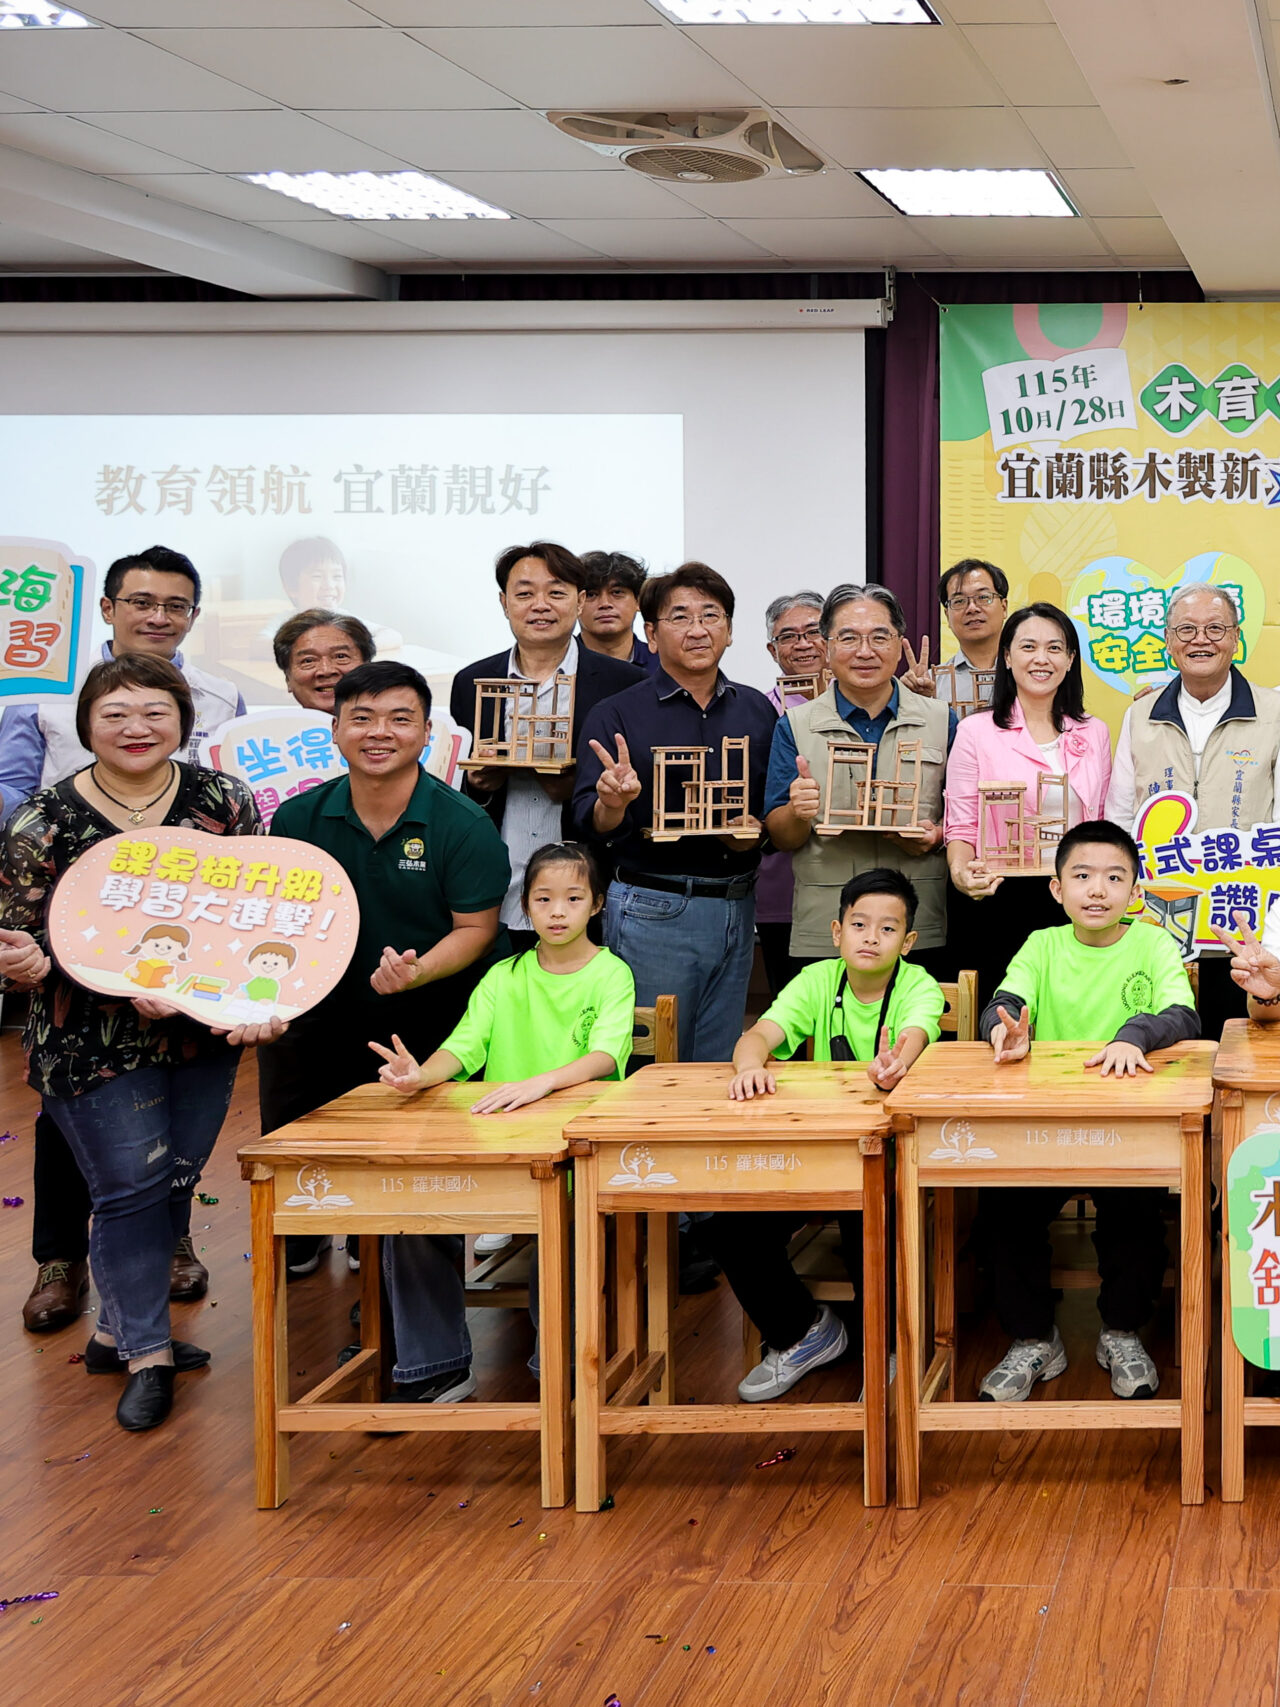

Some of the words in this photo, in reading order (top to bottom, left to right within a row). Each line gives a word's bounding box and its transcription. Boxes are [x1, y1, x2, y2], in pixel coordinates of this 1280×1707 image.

[1015, 363, 1098, 399] 115年
[999, 395, 1126, 437] 10月/28日
[94, 463, 313, 517] 教育領航
[332, 463, 553, 517] 宜蘭靚好
[1001, 452, 1280, 500] 宜蘭縣木製新
[4, 619, 62, 669] 習
[1025, 1129, 1048, 1146] 115
[1056, 1128, 1122, 1147] 羅東國小
[704, 1155, 728, 1171] 115
[735, 1153, 802, 1172] 羅東國小
[381, 1177, 404, 1193] 115
[412, 1175, 478, 1194] 羅東國小
